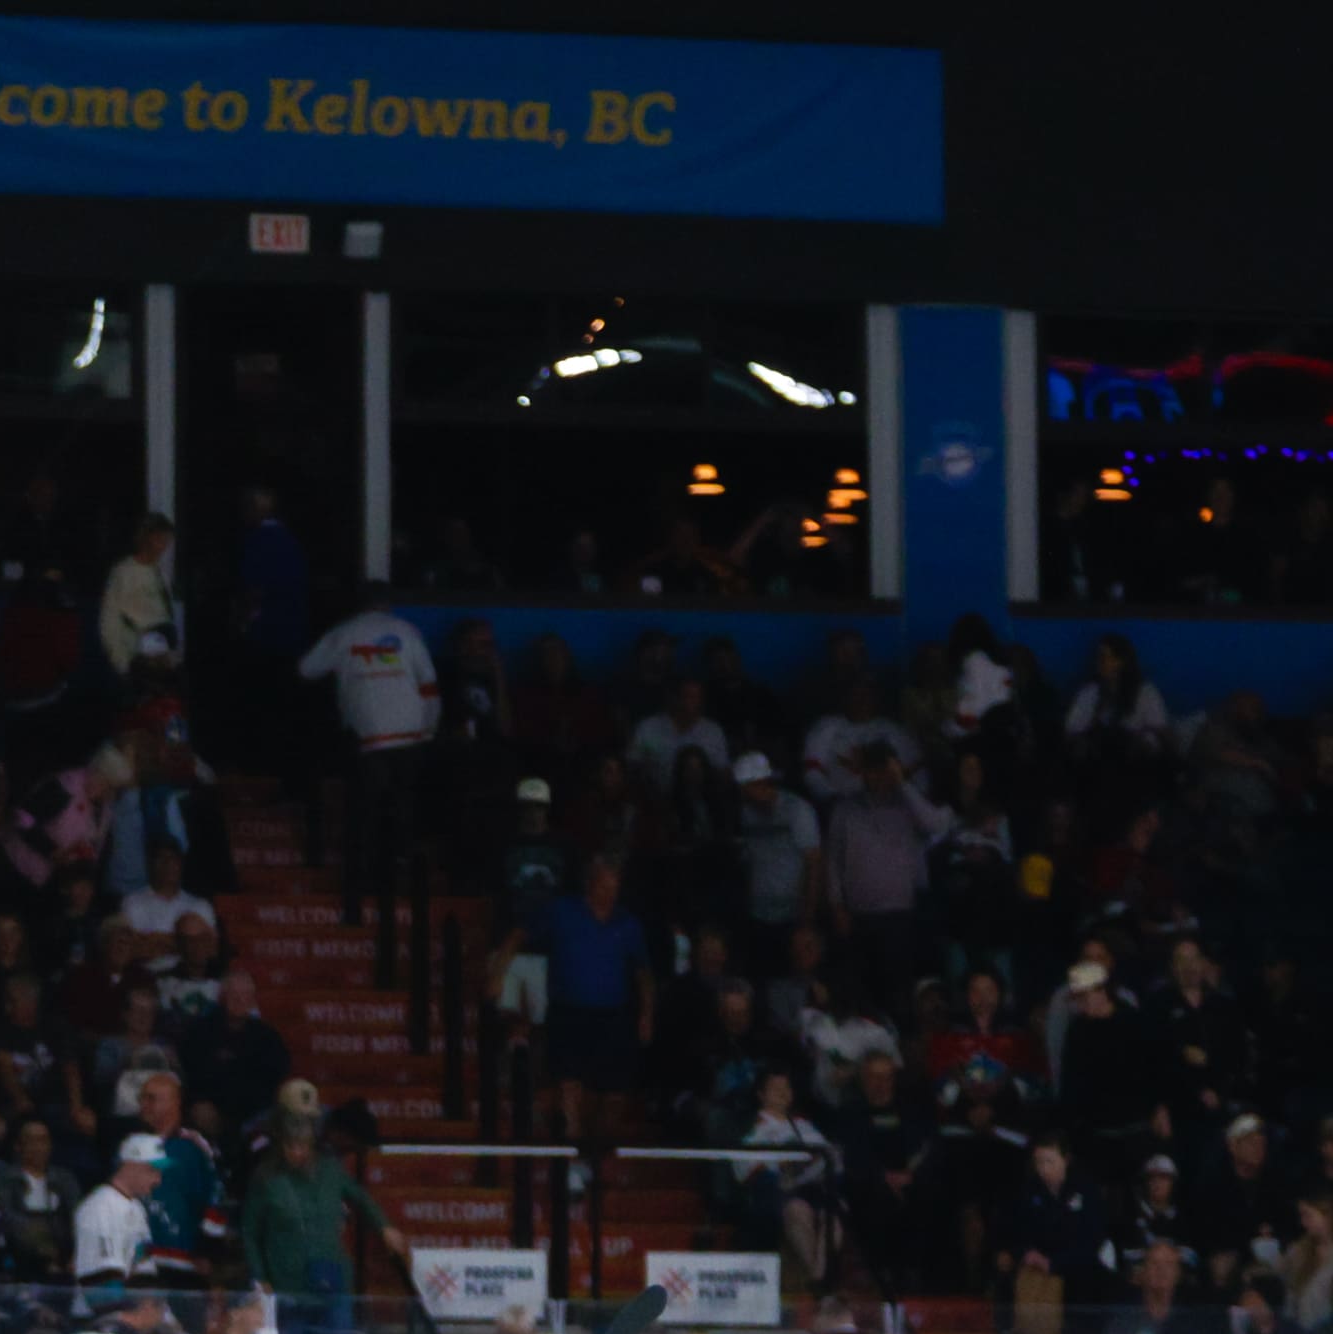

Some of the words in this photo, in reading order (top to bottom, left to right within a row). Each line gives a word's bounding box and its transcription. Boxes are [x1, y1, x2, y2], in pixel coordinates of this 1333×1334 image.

[183, 82, 248, 132] to
[265, 78, 566, 148] Kelowna,
[585, 91, 676, 147] BC
[258, 217, 305, 249] EXIT
